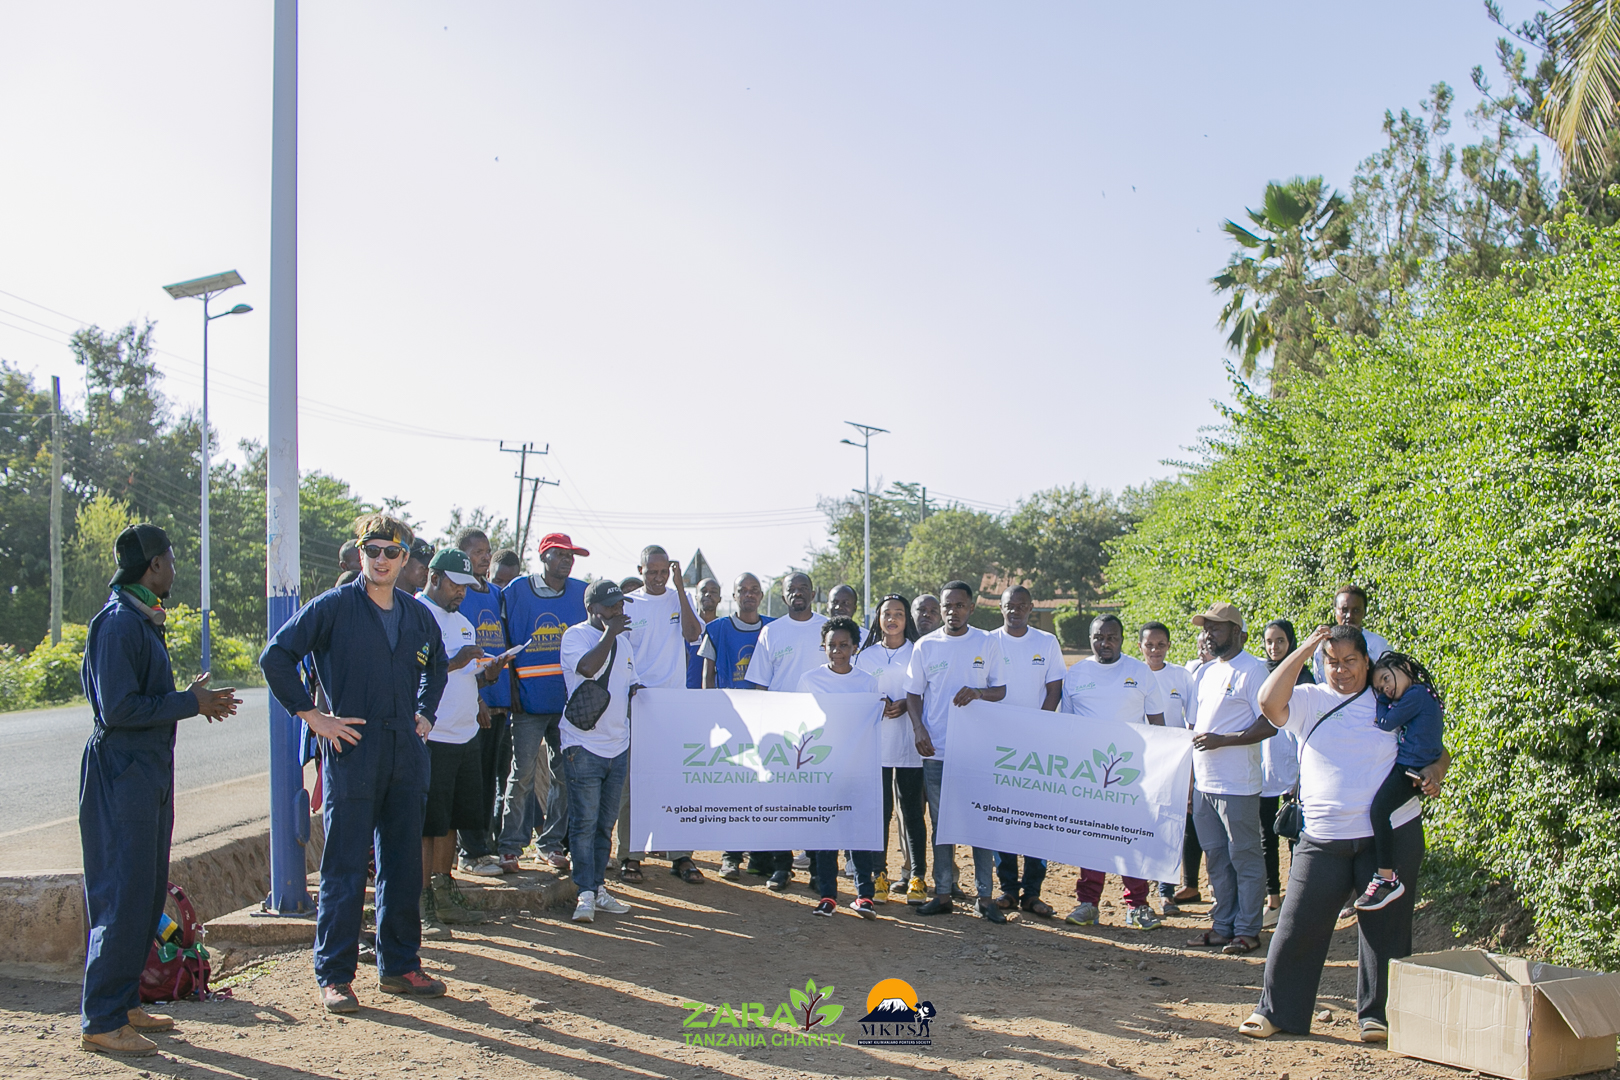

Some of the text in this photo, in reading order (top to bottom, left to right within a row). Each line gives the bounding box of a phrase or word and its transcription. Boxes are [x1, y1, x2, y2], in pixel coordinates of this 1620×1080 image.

[532, 634, 560, 642] MKPS
[682, 743, 790, 767] ZARA
[994, 745, 1098, 784] ZARA
[682, 771, 834, 784] TANZANIA CHARITY
[992, 773, 1140, 806] TANZANIA CHARITY
[674, 804, 703, 815] global
[704, 805, 753, 813] movement
[754, 804, 764, 812] of
[765, 804, 817, 812] sustainable
[818, 804, 853, 812] tourism
[680, 815, 697, 823] and
[698, 815, 727, 825] giving
[728, 815, 750, 823] back
[751, 815, 761, 823] to
[982, 803, 1010, 816] global
[1011, 808, 1058, 822] movement
[1058, 815, 1069, 823] of
[1069, 816, 1120, 832] sustainable
[1121, 824, 1155, 838] tourism
[987, 814, 1004, 824] and
[1004, 817, 1032, 829] giving
[1033, 821, 1055, 832] back
[1055, 825, 1065, 833] to
[1066, 827, 1082, 835] our
